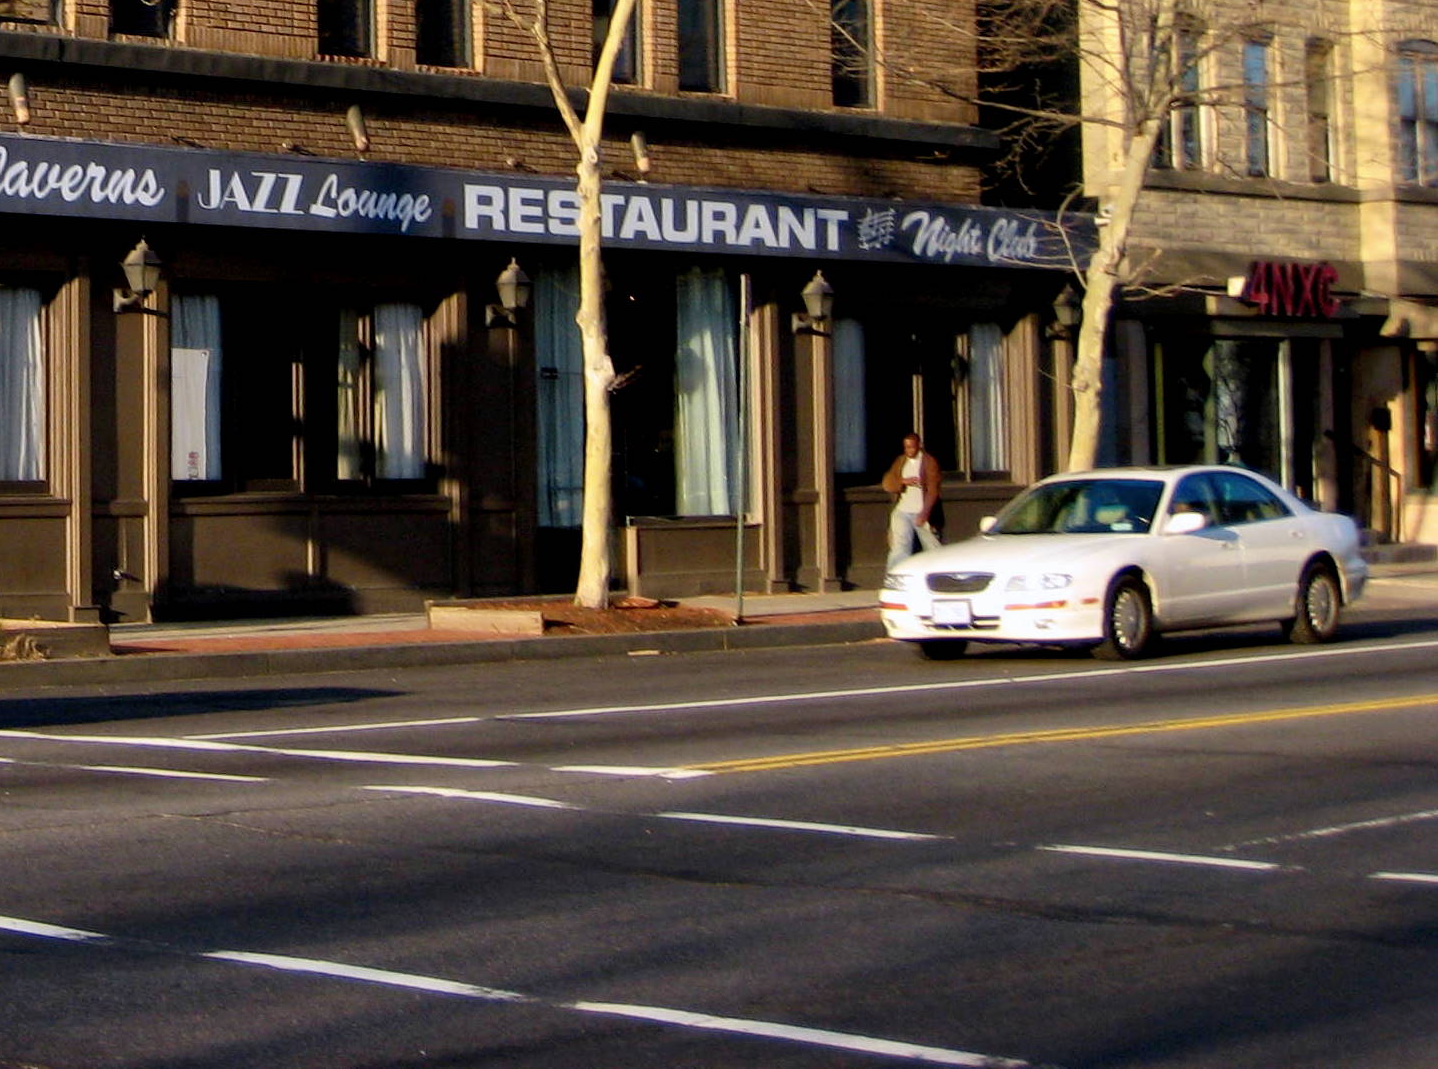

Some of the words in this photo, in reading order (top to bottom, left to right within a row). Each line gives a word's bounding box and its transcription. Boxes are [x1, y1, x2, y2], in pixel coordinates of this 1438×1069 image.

[197, 168, 305, 215] JAZZ
[309, 172, 433, 233] Lounge
[463, 183, 850, 252] RESTAURANT
[901, 210, 984, 263] Night
[986, 217, 1039, 263] Club
